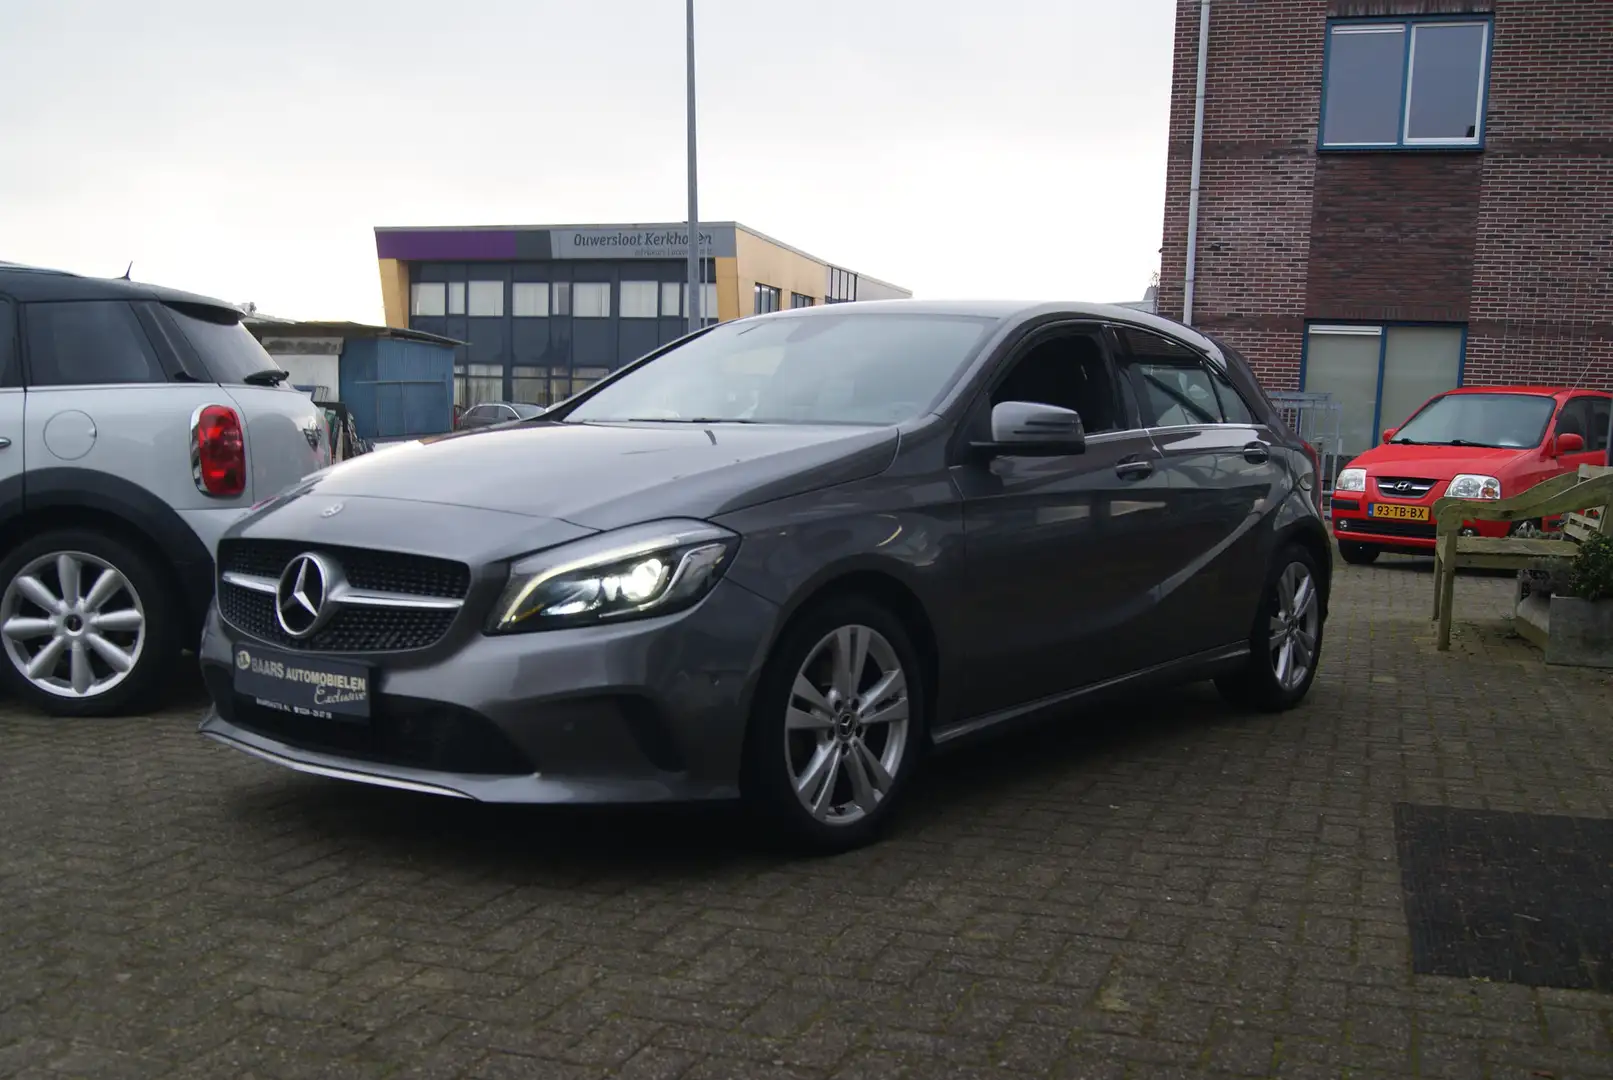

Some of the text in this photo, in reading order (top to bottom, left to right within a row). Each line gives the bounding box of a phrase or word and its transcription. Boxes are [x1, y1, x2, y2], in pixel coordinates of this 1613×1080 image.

[573, 231, 712, 246] Ouwersloot Kerkhoen
[1377, 505, 1424, 518] 93-TB-BX
[251, 658, 366, 690] BAARS AUTOMOBIELEN
[314, 683, 367, 705] Exclusive
